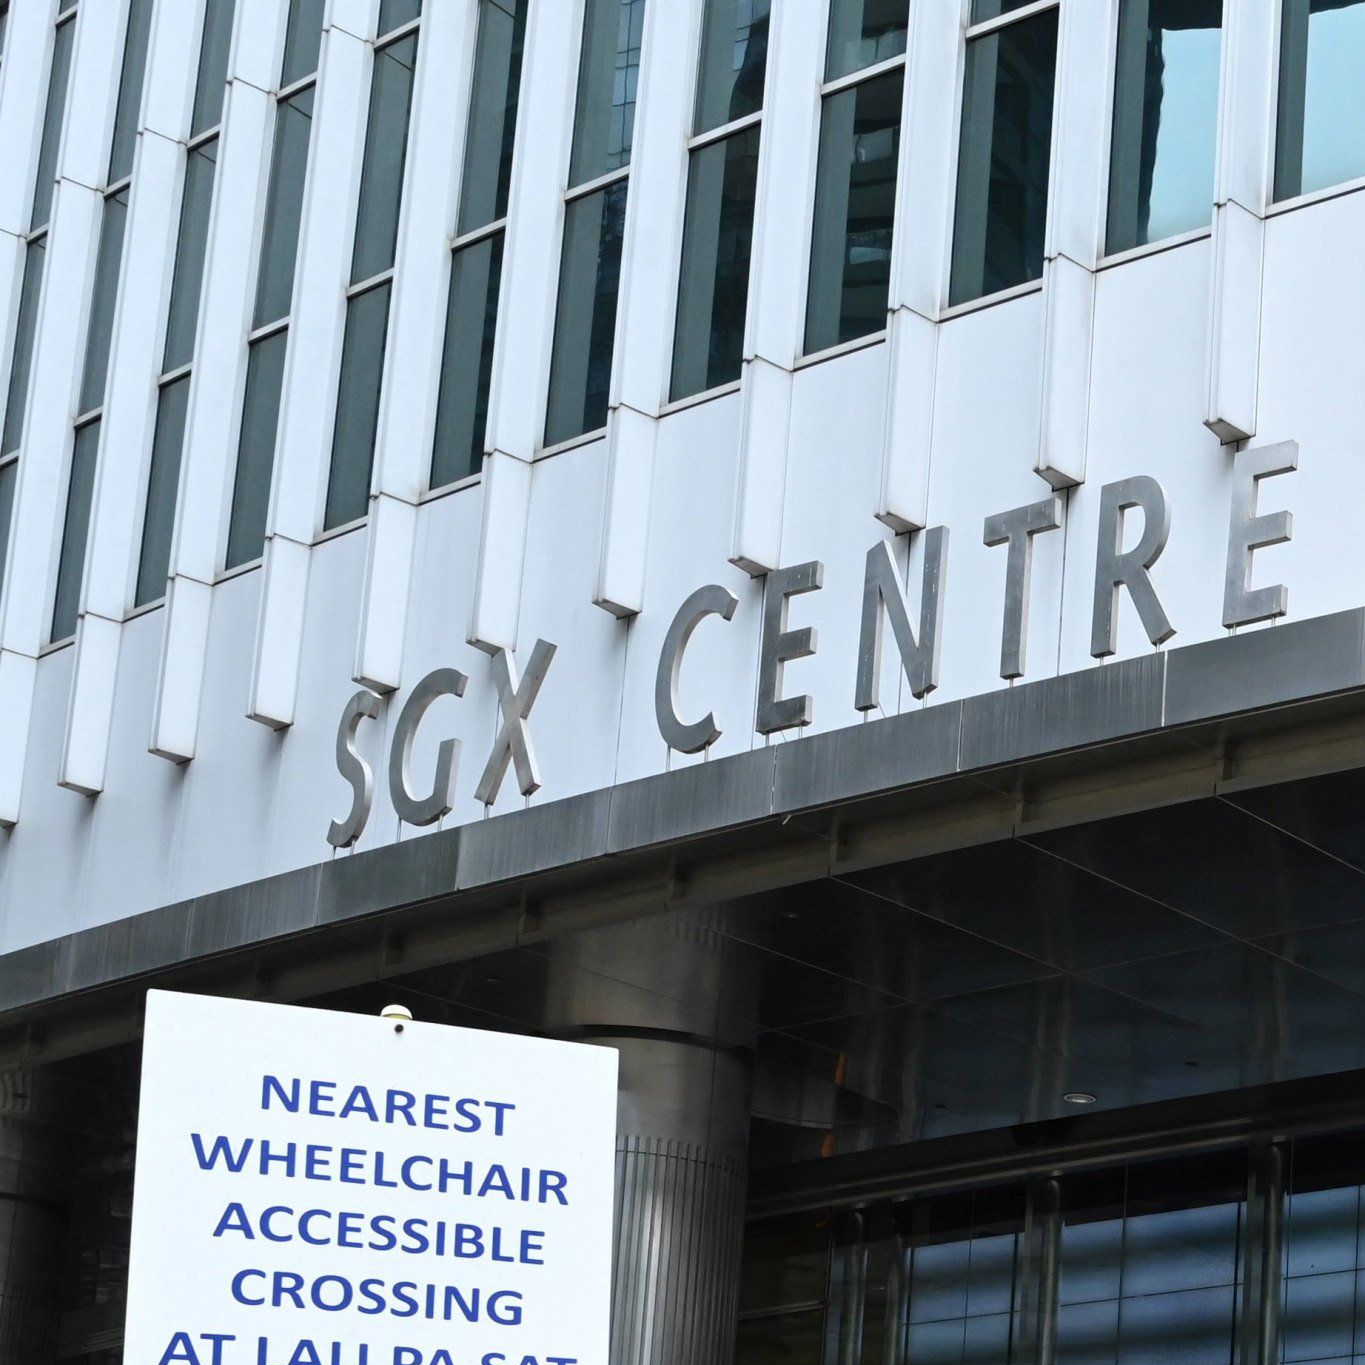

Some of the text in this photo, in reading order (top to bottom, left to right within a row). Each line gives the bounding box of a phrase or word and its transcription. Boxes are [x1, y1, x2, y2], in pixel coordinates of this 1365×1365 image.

[326, 638, 558, 848] SGX
[655, 439, 1298, 755] CENTRE
[261, 1075, 516, 1136] NEAREST
[191, 1133, 569, 1206] WHEELCHAIR
[213, 1202, 546, 1266] ACCESSIBLE
[231, 1269, 524, 1326] CROSSING
